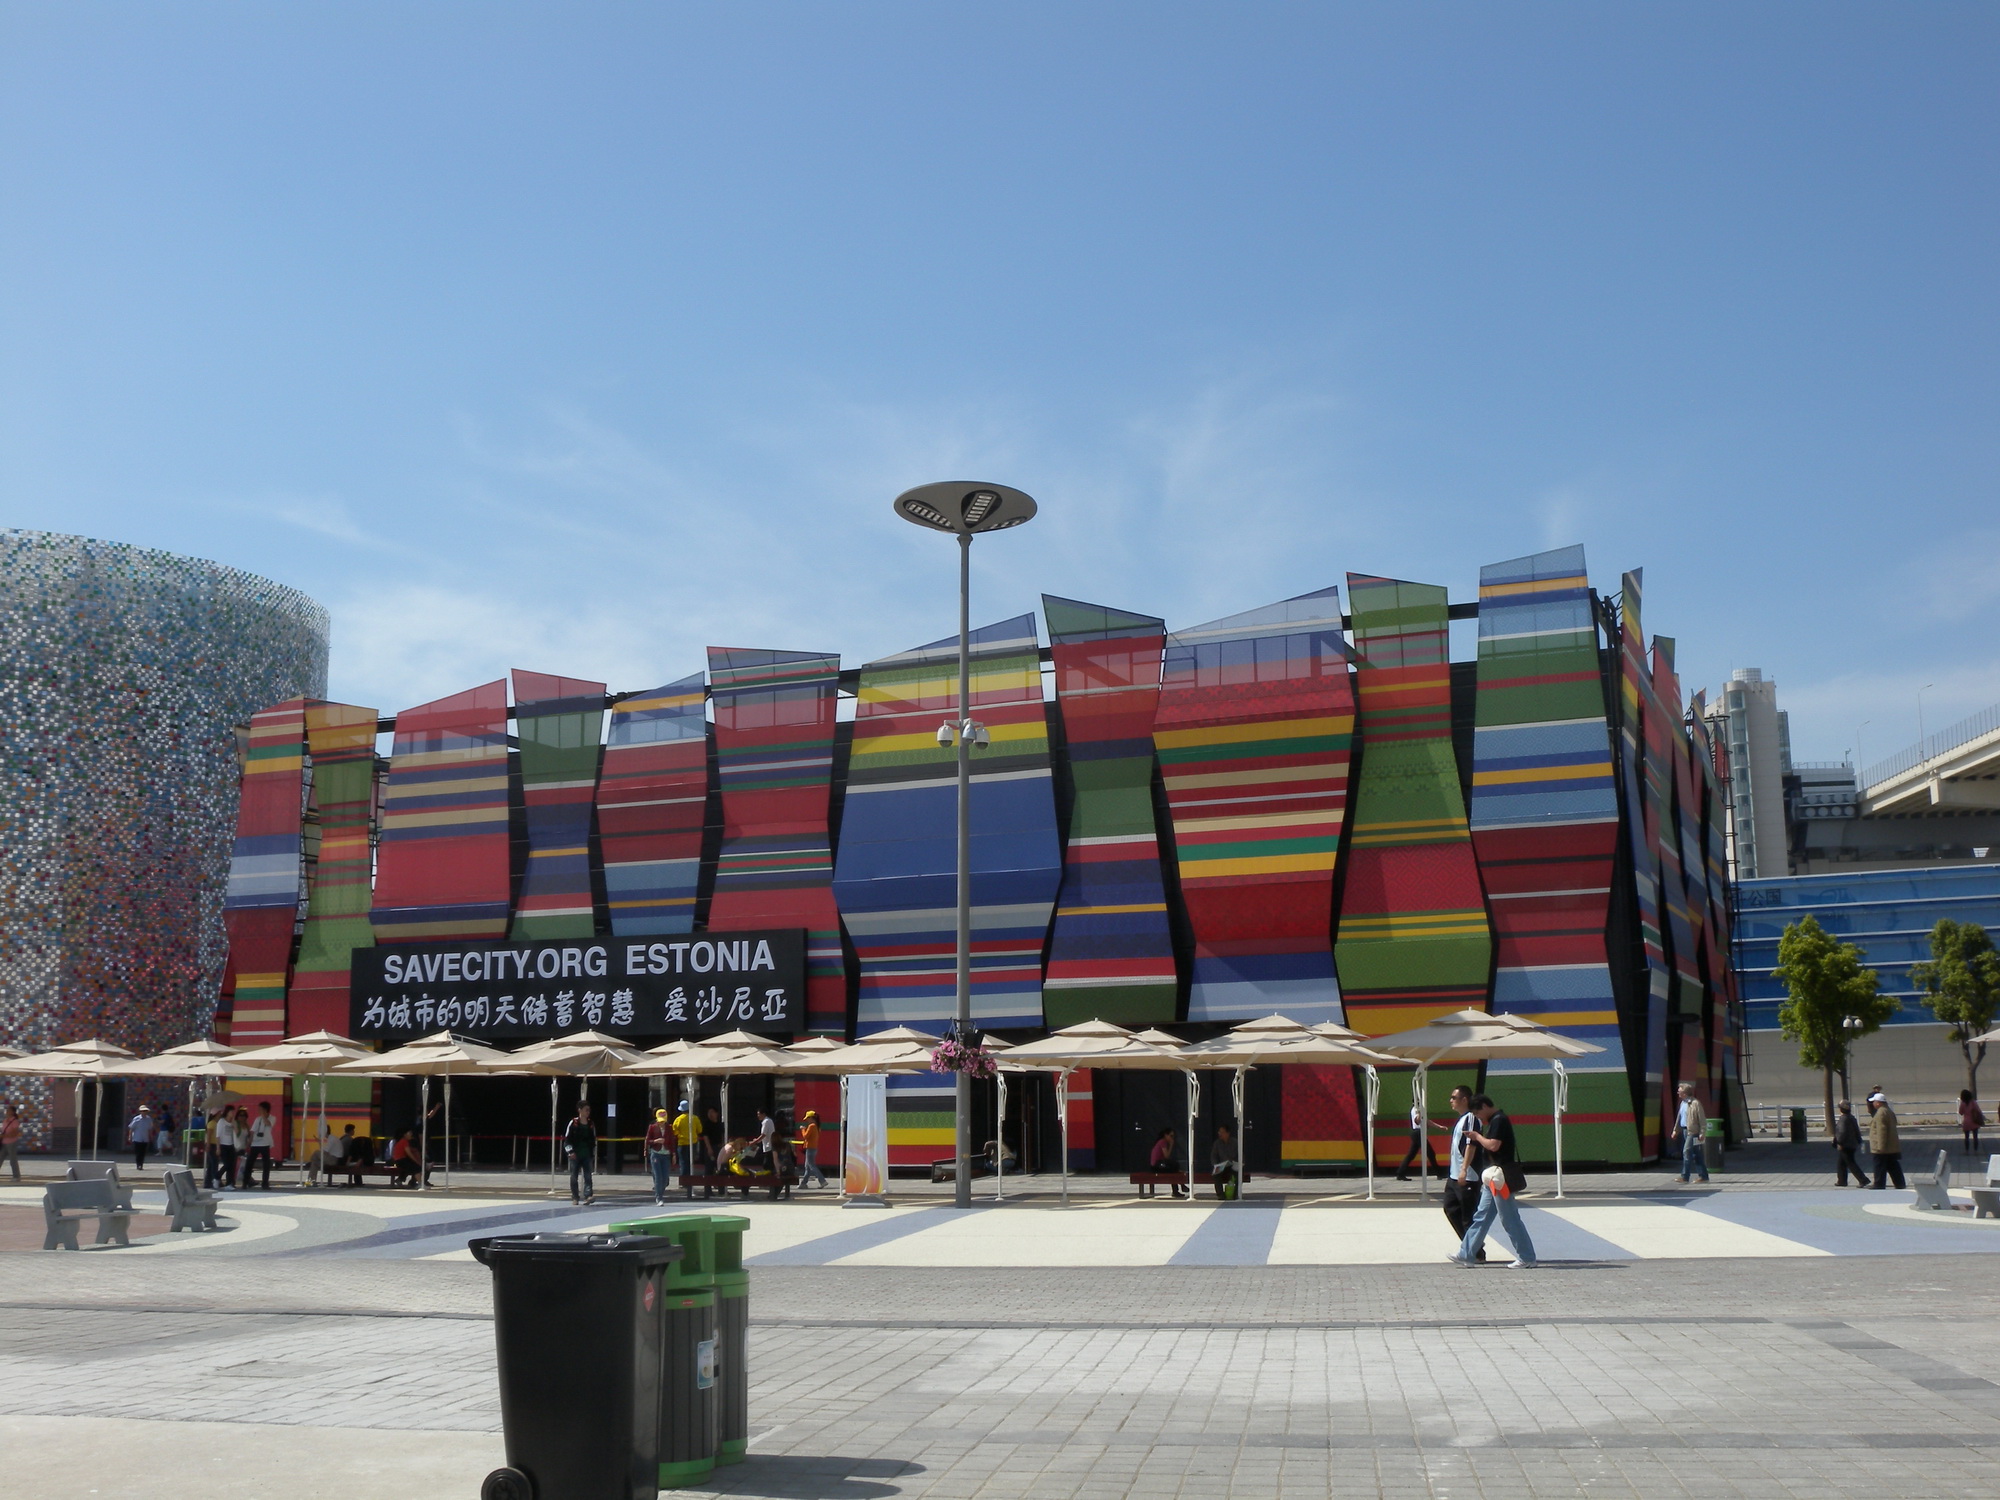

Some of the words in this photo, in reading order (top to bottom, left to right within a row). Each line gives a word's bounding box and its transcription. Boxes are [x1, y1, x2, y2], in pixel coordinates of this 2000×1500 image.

[384, 946, 608, 984] SAVECITY.ORG
[626, 939, 776, 975] ESTONIA
[360, 987, 635, 1031] 为城市的明天储蓄智慧
[664, 985, 788, 1025] 爱沙尼亚
